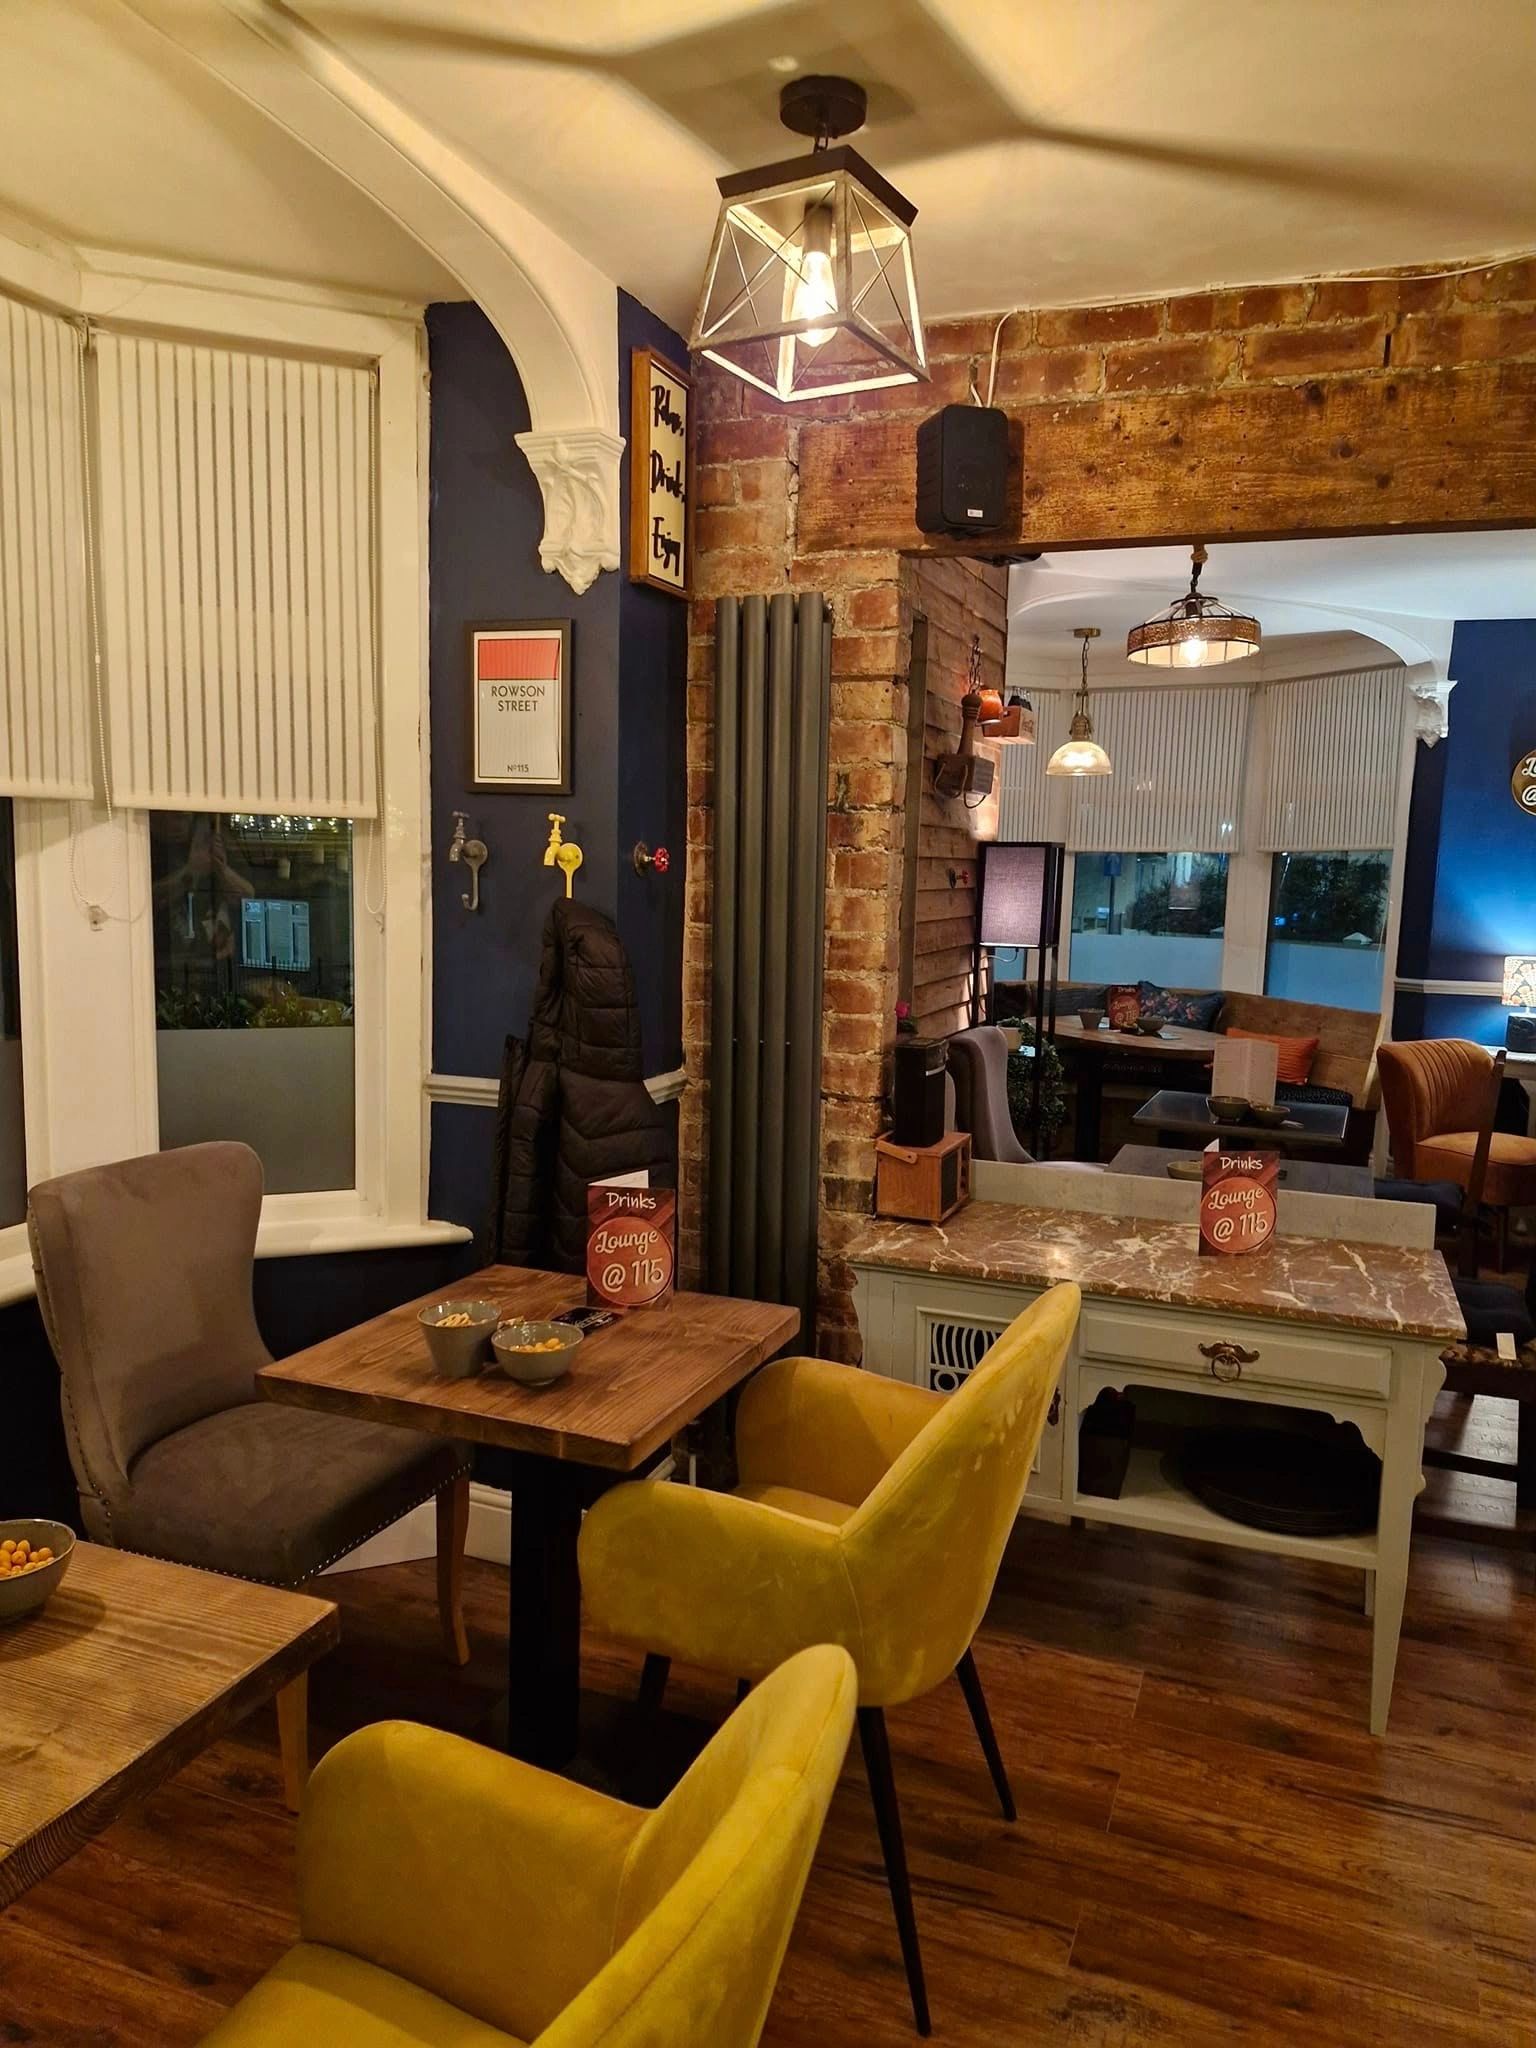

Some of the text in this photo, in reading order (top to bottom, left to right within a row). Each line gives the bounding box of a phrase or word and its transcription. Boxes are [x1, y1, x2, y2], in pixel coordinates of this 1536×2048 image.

[491, 685, 545, 698] ROWSON
[497, 699, 538, 712] STREET
[1219, 1156, 1263, 1170] Drinks
[606, 1192, 657, 1209] Drinks
[1208, 1187, 1264, 1210] Lounge
[1213, 1211, 1268, 1243] @ 115
[595, 1230, 659, 1255] Lounge
[602, 1258, 664, 1293] @ 115
